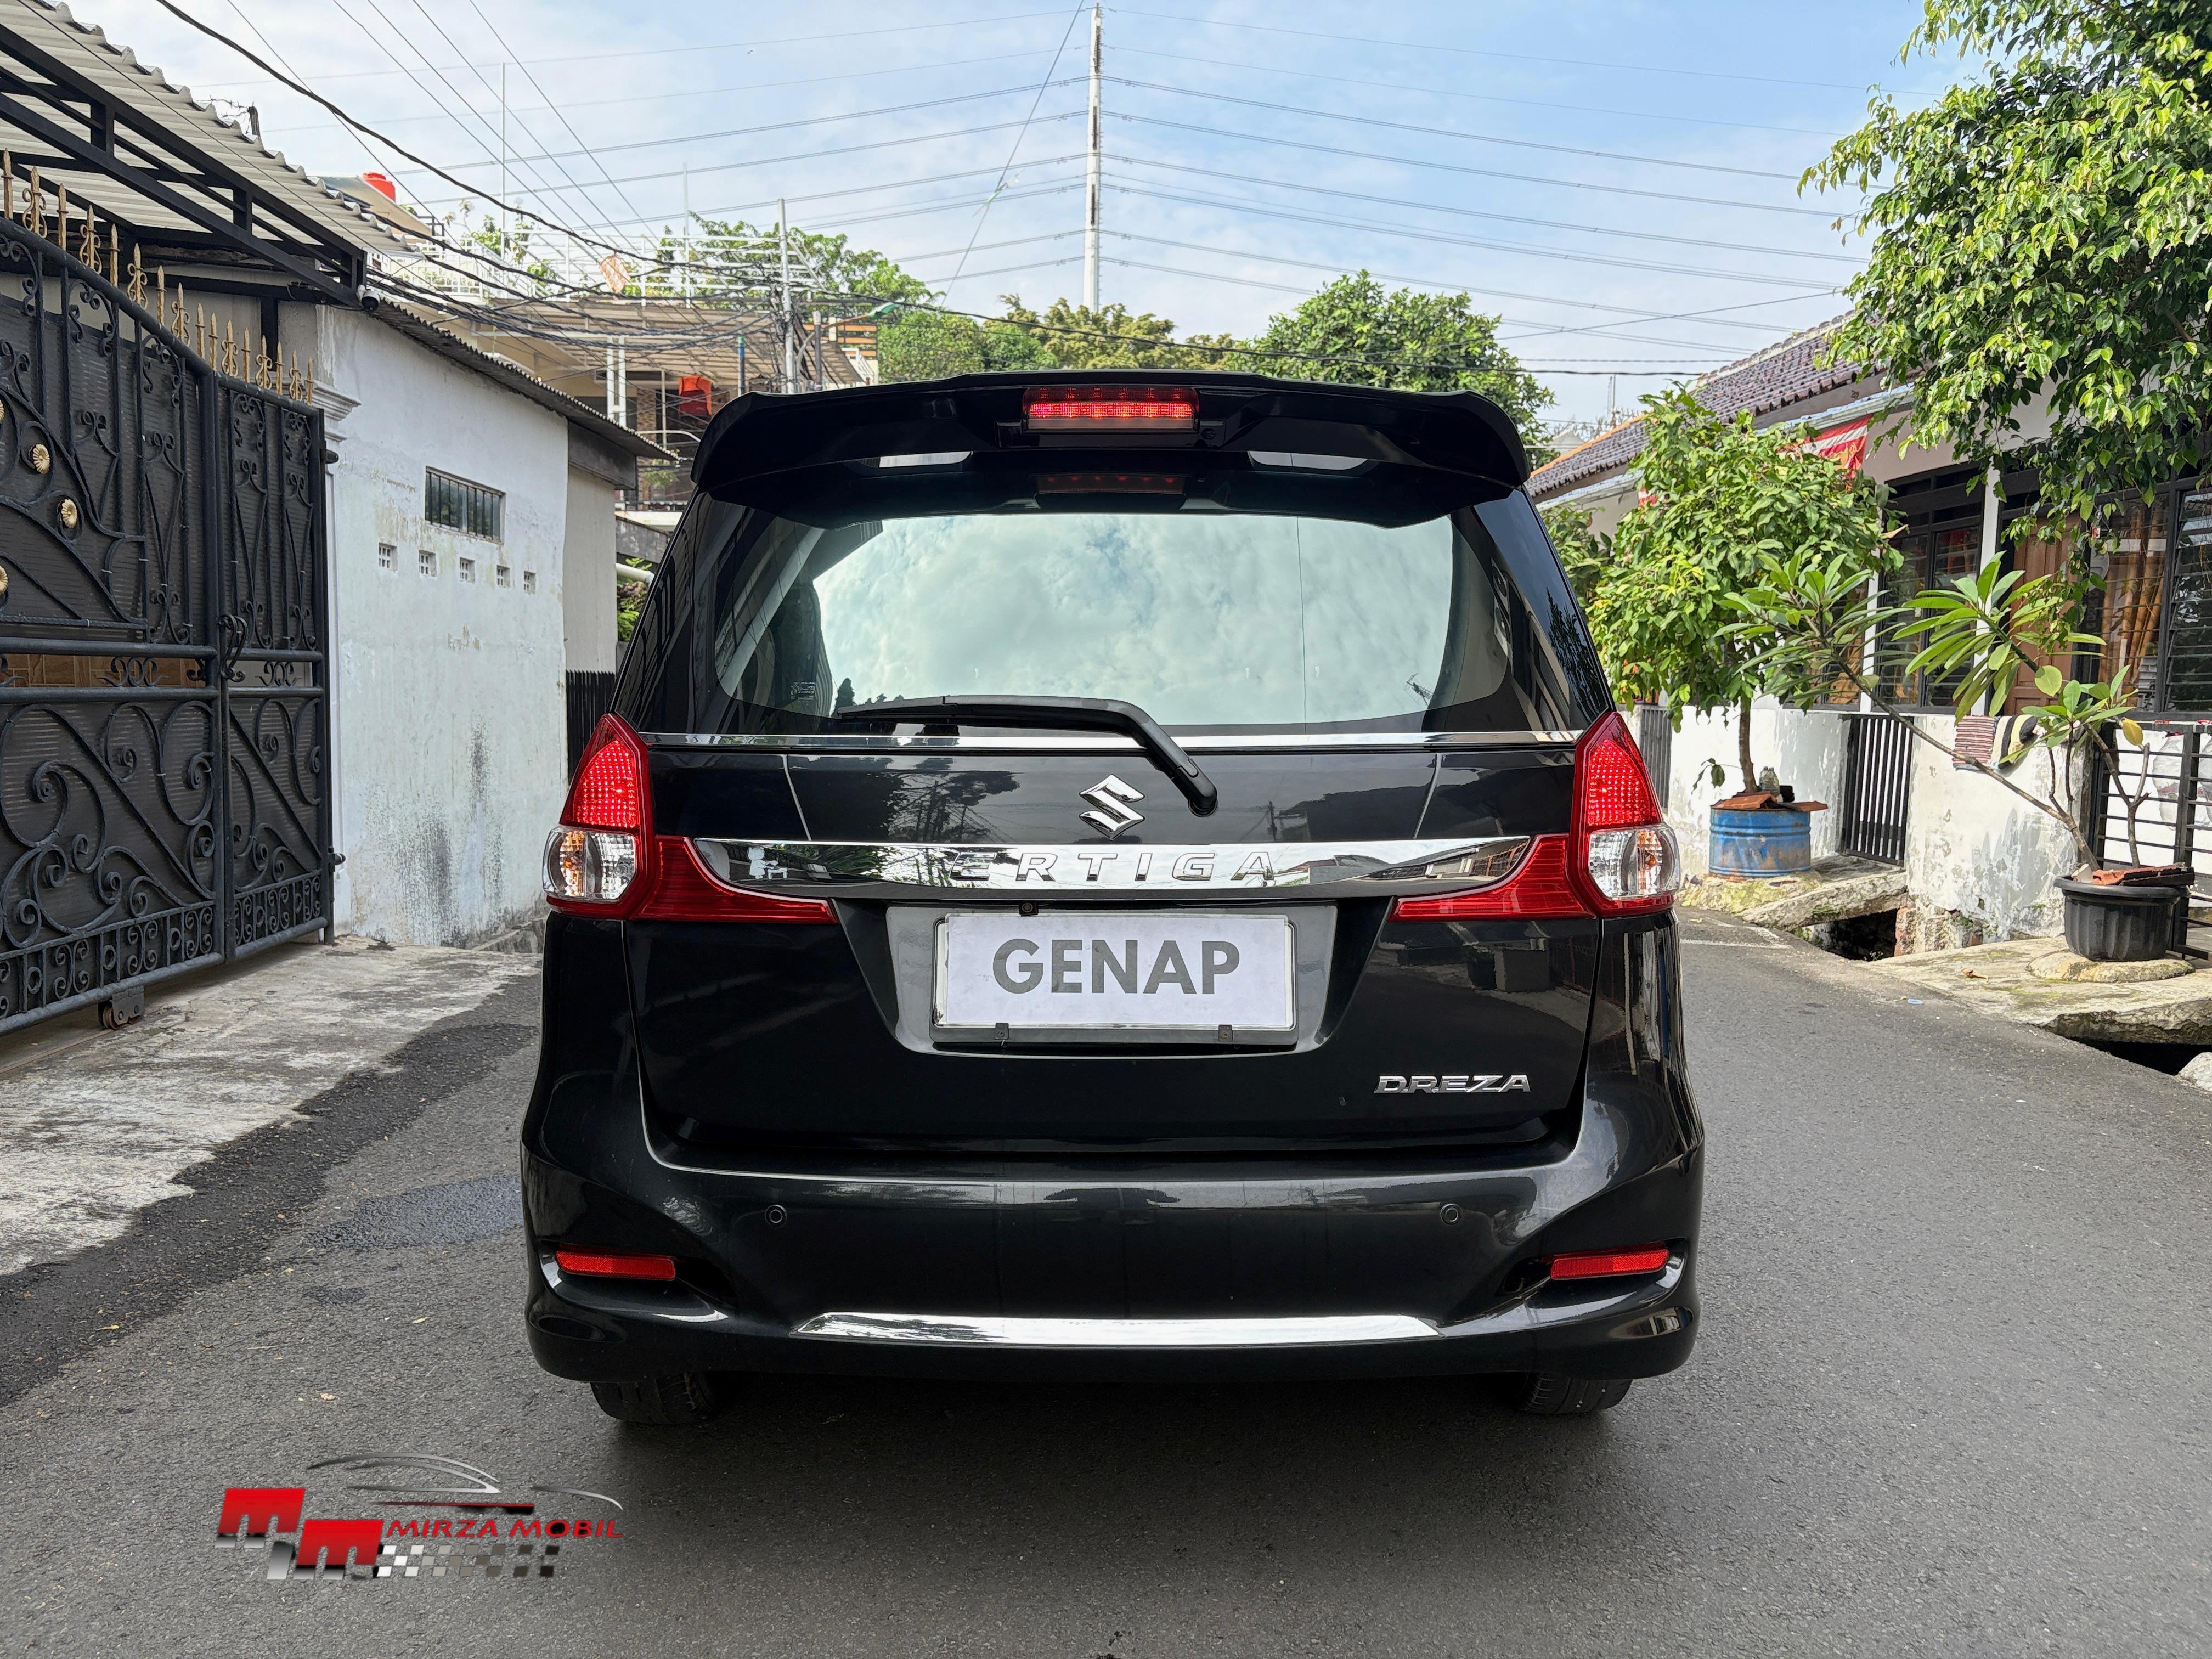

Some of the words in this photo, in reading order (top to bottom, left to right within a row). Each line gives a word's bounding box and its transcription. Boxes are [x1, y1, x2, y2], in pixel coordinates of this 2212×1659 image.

[950, 851, 1274, 882] ERTIGA
[992, 938, 1240, 995] GENAP
[1373, 1074, 1531, 1094] DREZA
